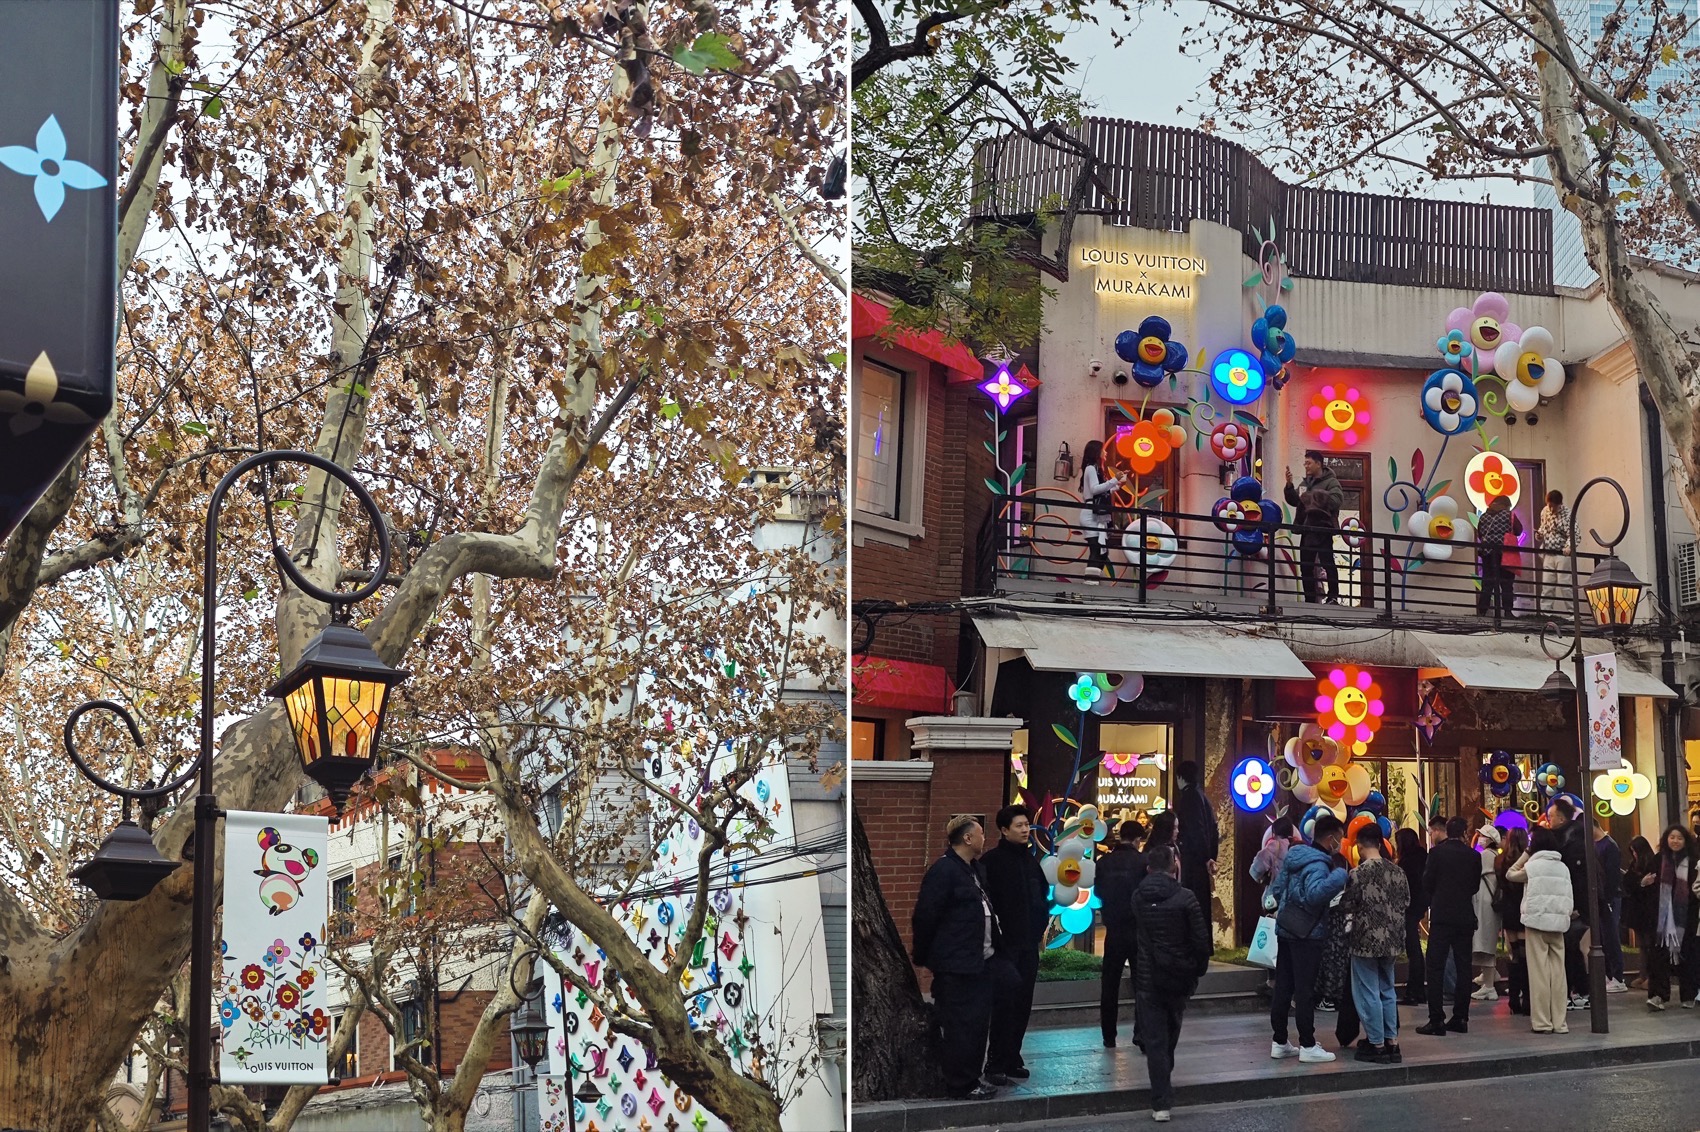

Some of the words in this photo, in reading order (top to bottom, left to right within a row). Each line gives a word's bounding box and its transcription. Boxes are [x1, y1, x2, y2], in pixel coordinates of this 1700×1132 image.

[1082, 248, 1129, 266] LOUIS
[1134, 253, 1205, 272] VUITTON
[1096, 278, 1190, 299] MURAKAMI
[1097, 777, 1113, 788] UIS
[1115, 777, 1157, 788] VUITTON
[244, 1062, 273, 1073] LOUIS
[274, 1062, 314, 1071] VUITTON
